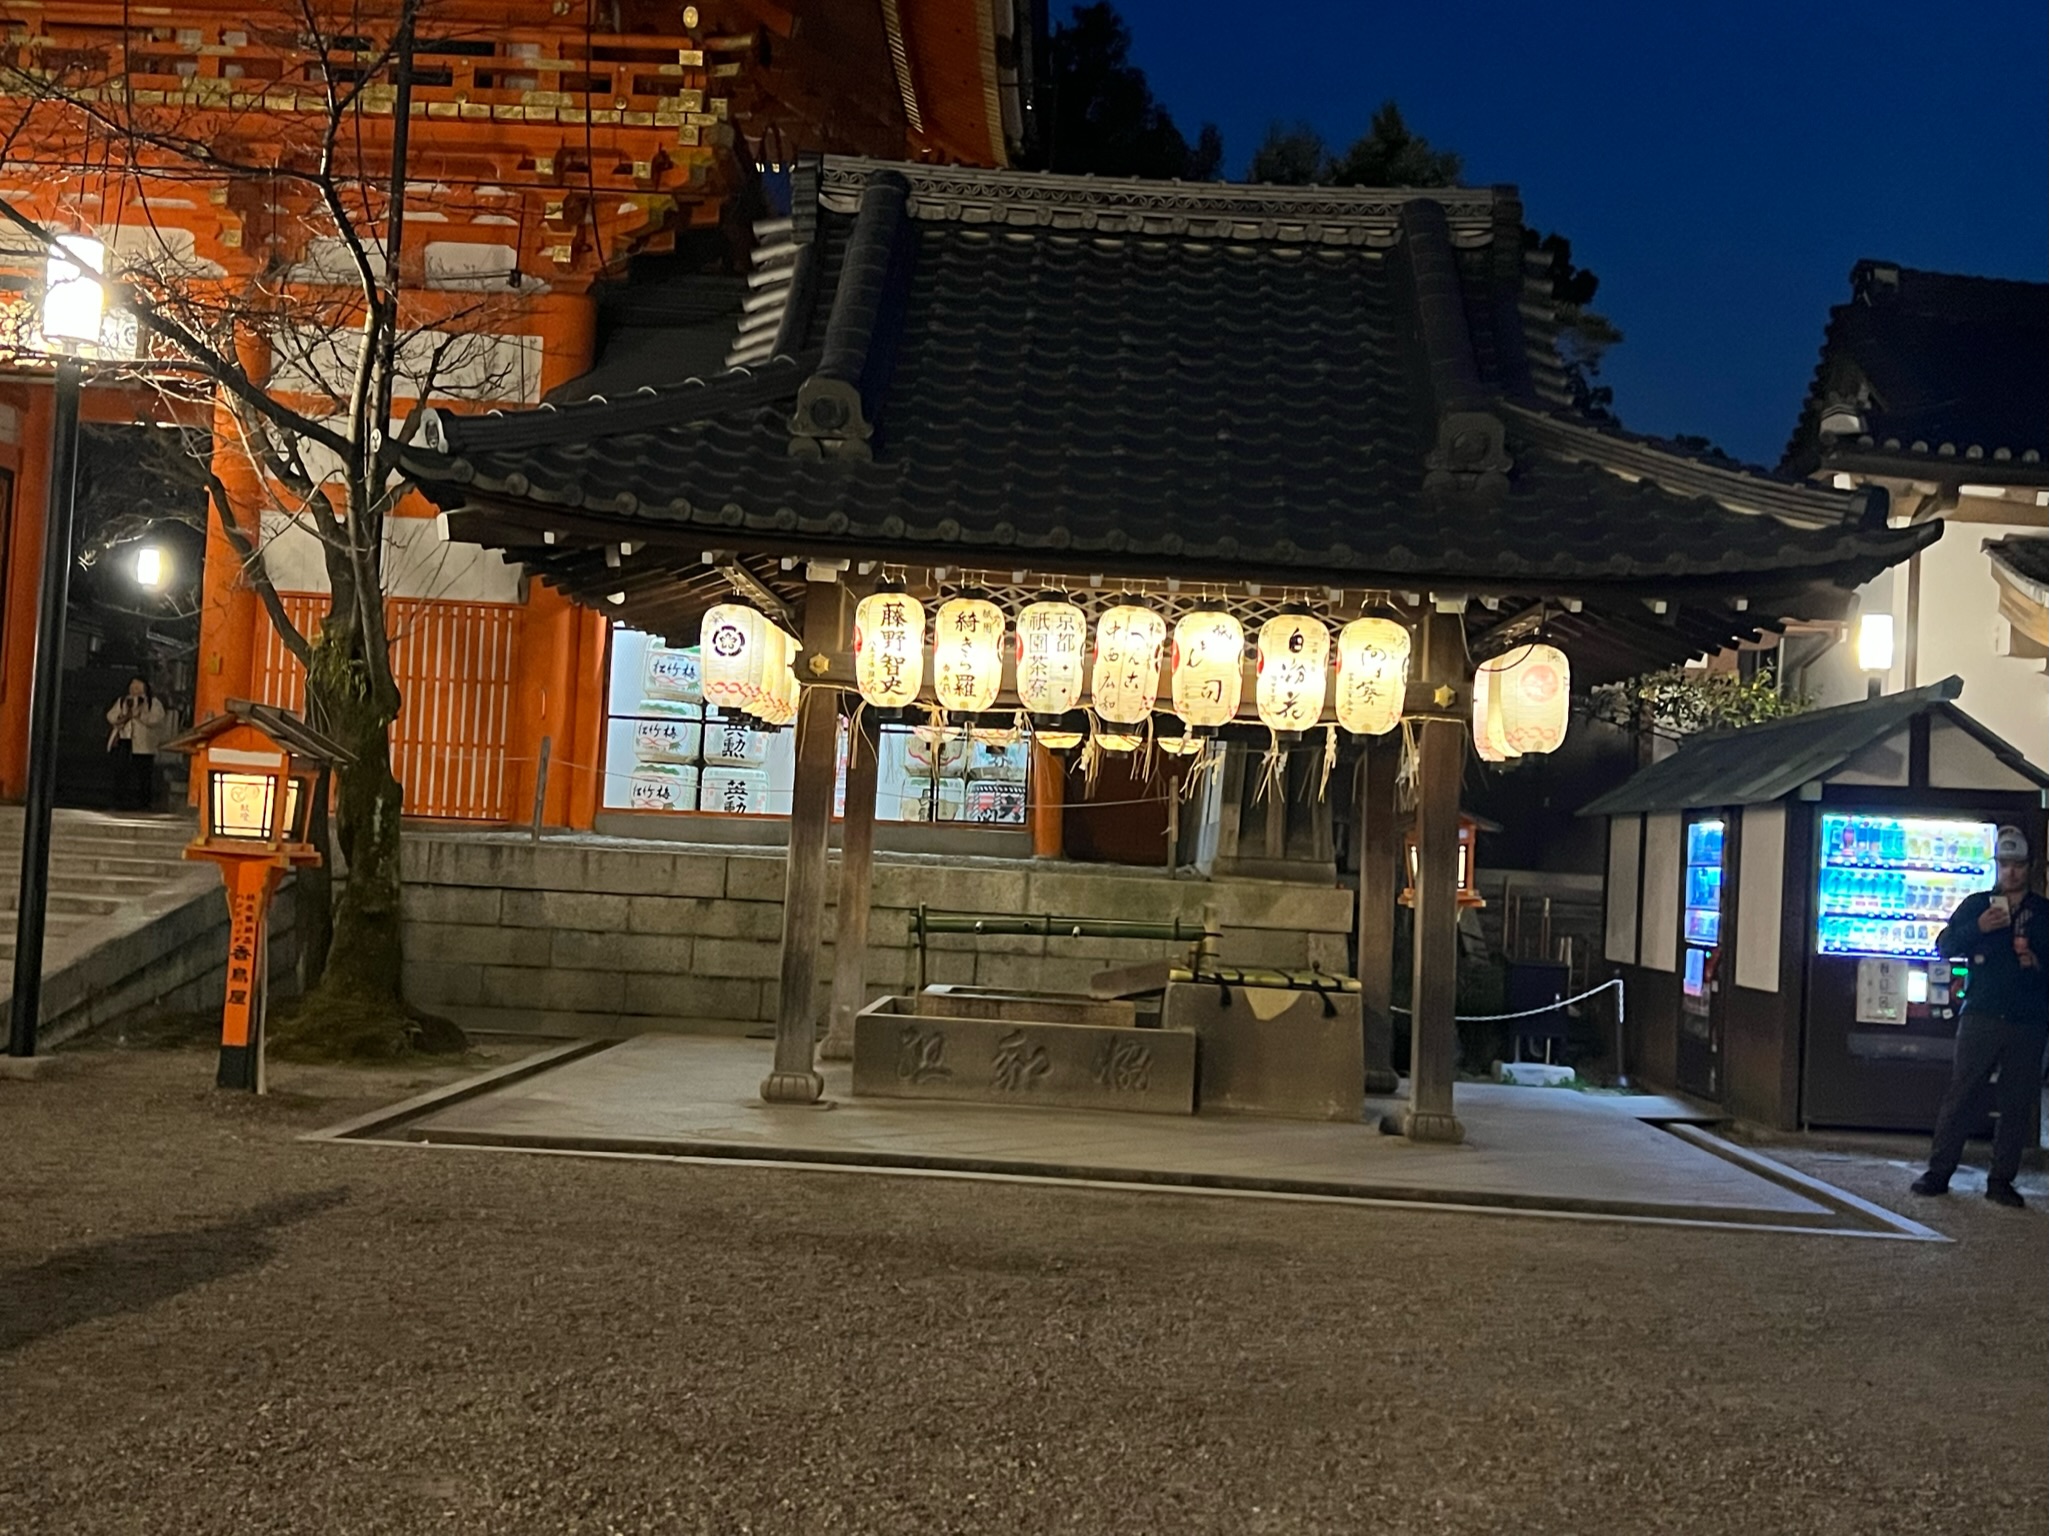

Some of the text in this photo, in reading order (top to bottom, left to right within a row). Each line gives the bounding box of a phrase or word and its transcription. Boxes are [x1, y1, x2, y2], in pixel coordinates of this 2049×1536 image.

[653, 660, 697, 680] 松竹梅
[878, 600, 909, 697] 藤野智史
